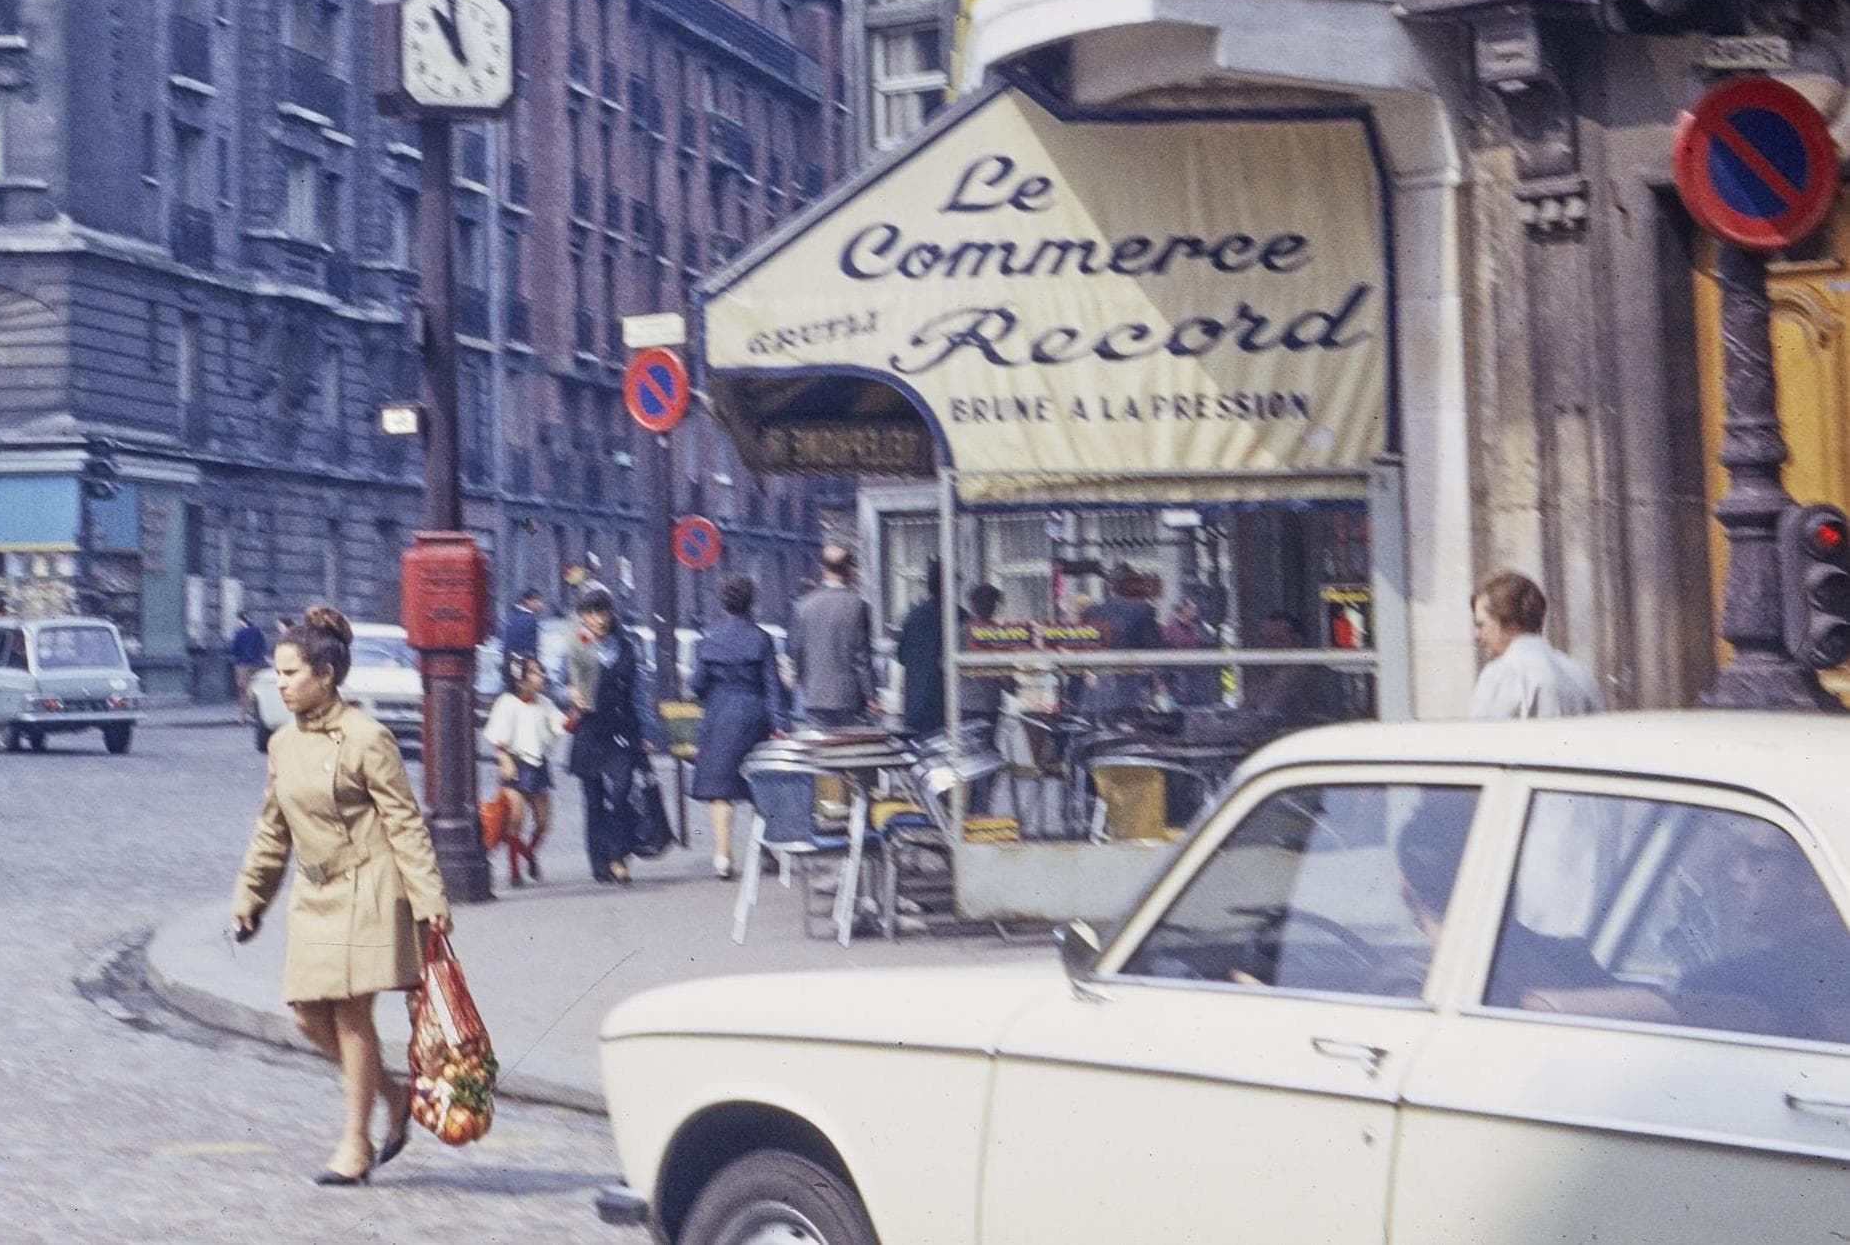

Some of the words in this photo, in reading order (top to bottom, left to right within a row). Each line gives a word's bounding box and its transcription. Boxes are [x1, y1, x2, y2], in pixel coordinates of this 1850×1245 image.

[938, 154, 1054, 212] Le
[839, 223, 1311, 280] Commerce
[890, 282, 1372, 373] Record
[950, 396, 1050, 423] BRUNE
[1100, 395, 1144, 423] LA
[1151, 391, 1310, 423] PRESSION
